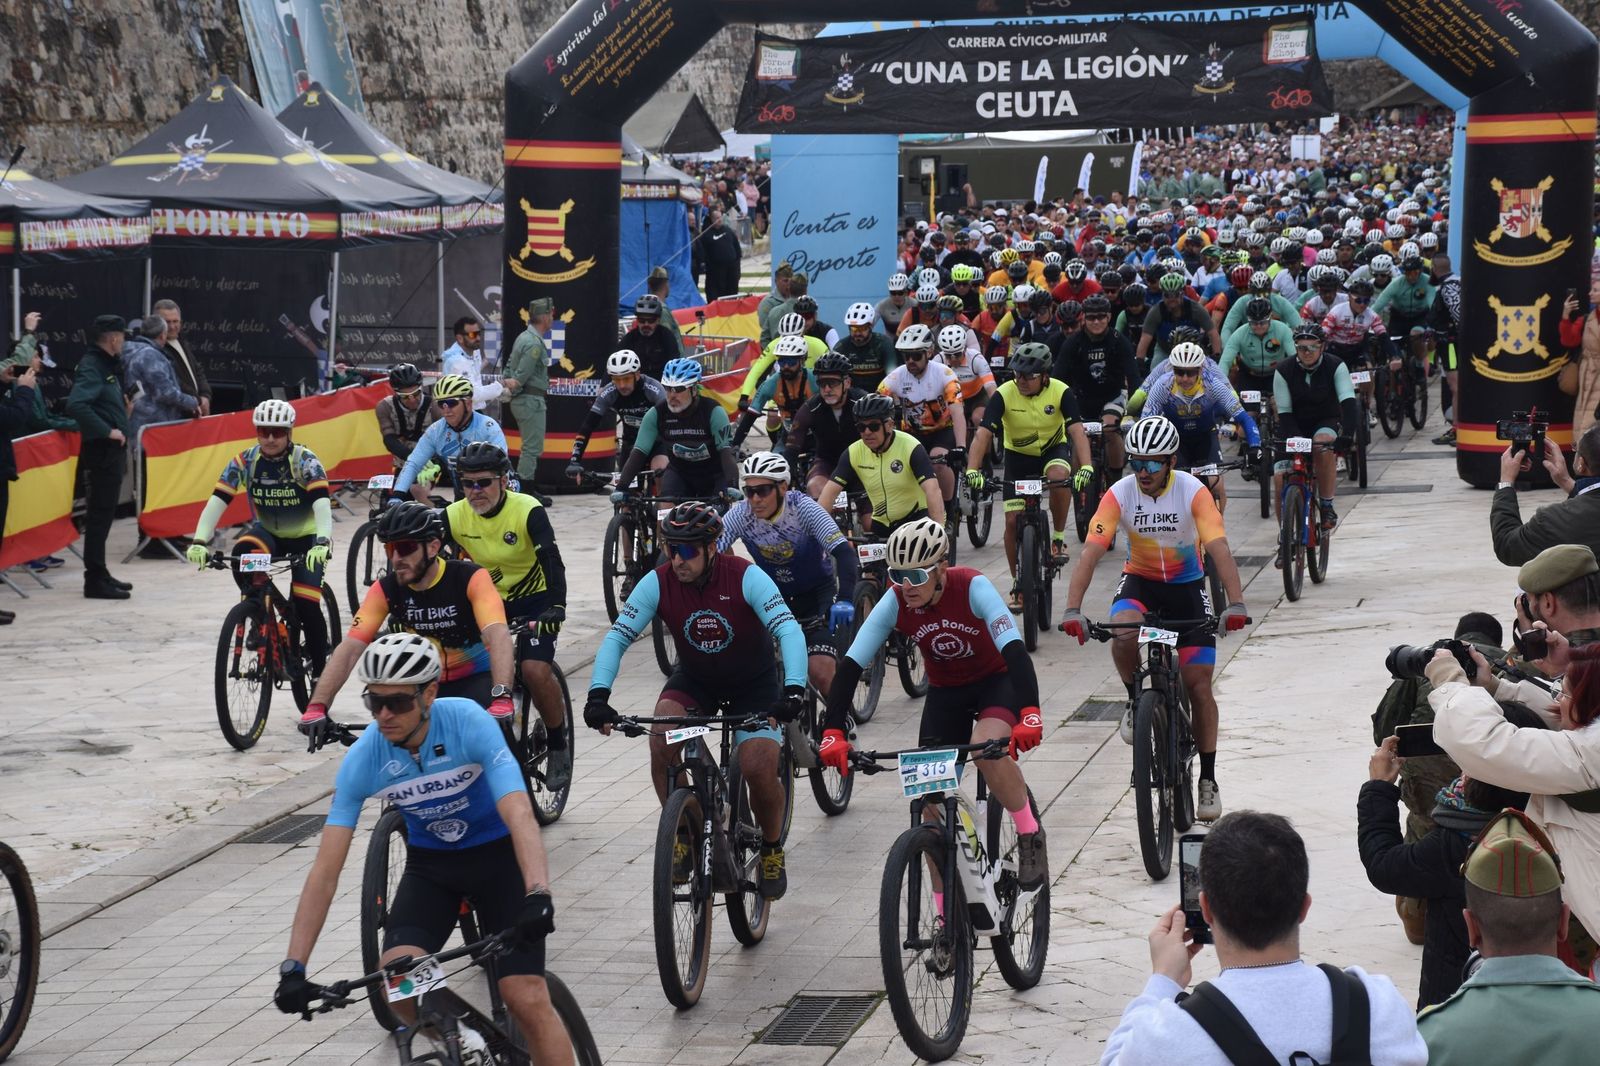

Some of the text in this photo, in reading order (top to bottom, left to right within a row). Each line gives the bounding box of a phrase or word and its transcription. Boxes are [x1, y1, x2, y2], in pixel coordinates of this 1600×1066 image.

[592, 2, 608, 27] del
[947, 31, 1108, 49] CARRERA CÍVICO-MILITAR
[1274, 32, 1290, 41] The
[762, 50, 778, 58] The
[977, 59, 1011, 83] DE
[1020, 58, 1055, 81] LA
[975, 91, 1079, 119] CEUTA
[151, 207, 309, 238] EPORTIVO
[783, 210, 879, 238] Ceuta es
[786, 246, 880, 284] Deporte
[252, 486, 296, 497] LA LEGIÓN
[1133, 512, 1179, 526] FIT BIKE
[405, 605, 459, 621] FIT BIKE
[911, 618, 981, 643] Gallos Ronda
[937, 640, 957, 651] BTT
[922, 762, 947, 777] 315
[387, 786, 415, 801] SAN
[416, 770, 474, 795] URBANO
[414, 967, 434, 984] 53
